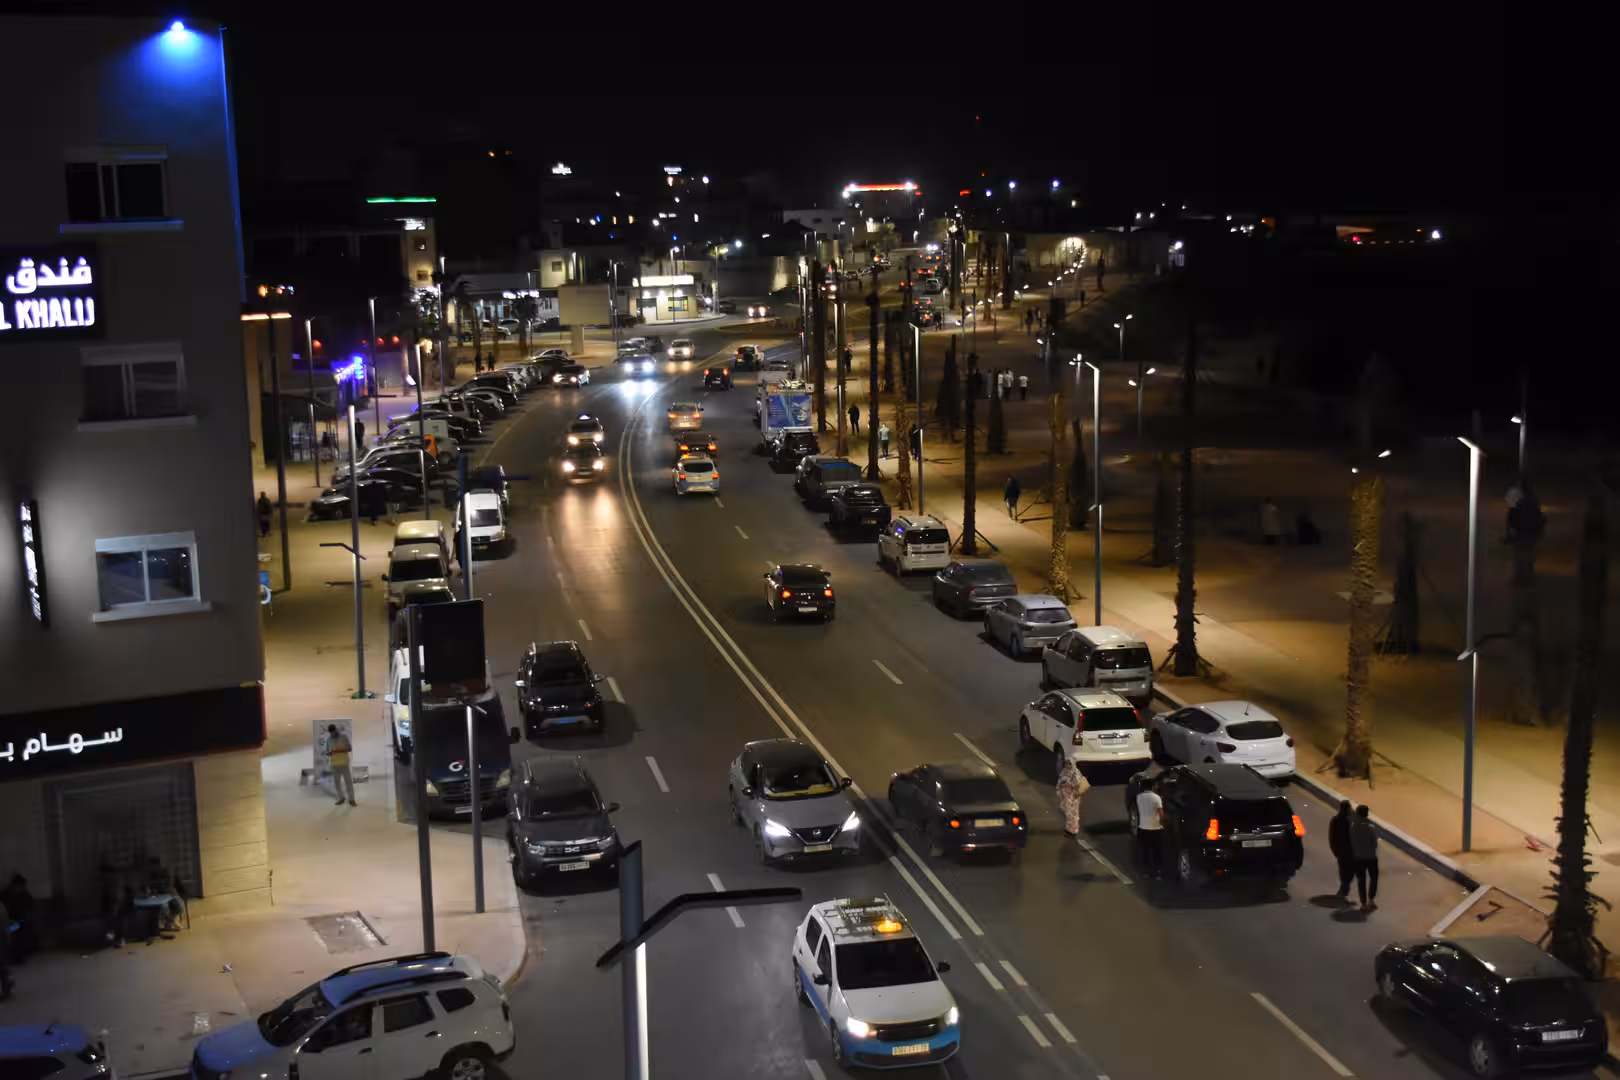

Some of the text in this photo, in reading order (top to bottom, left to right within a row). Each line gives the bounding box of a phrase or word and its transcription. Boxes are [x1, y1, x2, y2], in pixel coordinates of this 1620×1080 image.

[6, 256, 93, 294] فندق
[15, 296, 96, 329] KHALIJ
[22, 727, 124, 761] سهام
